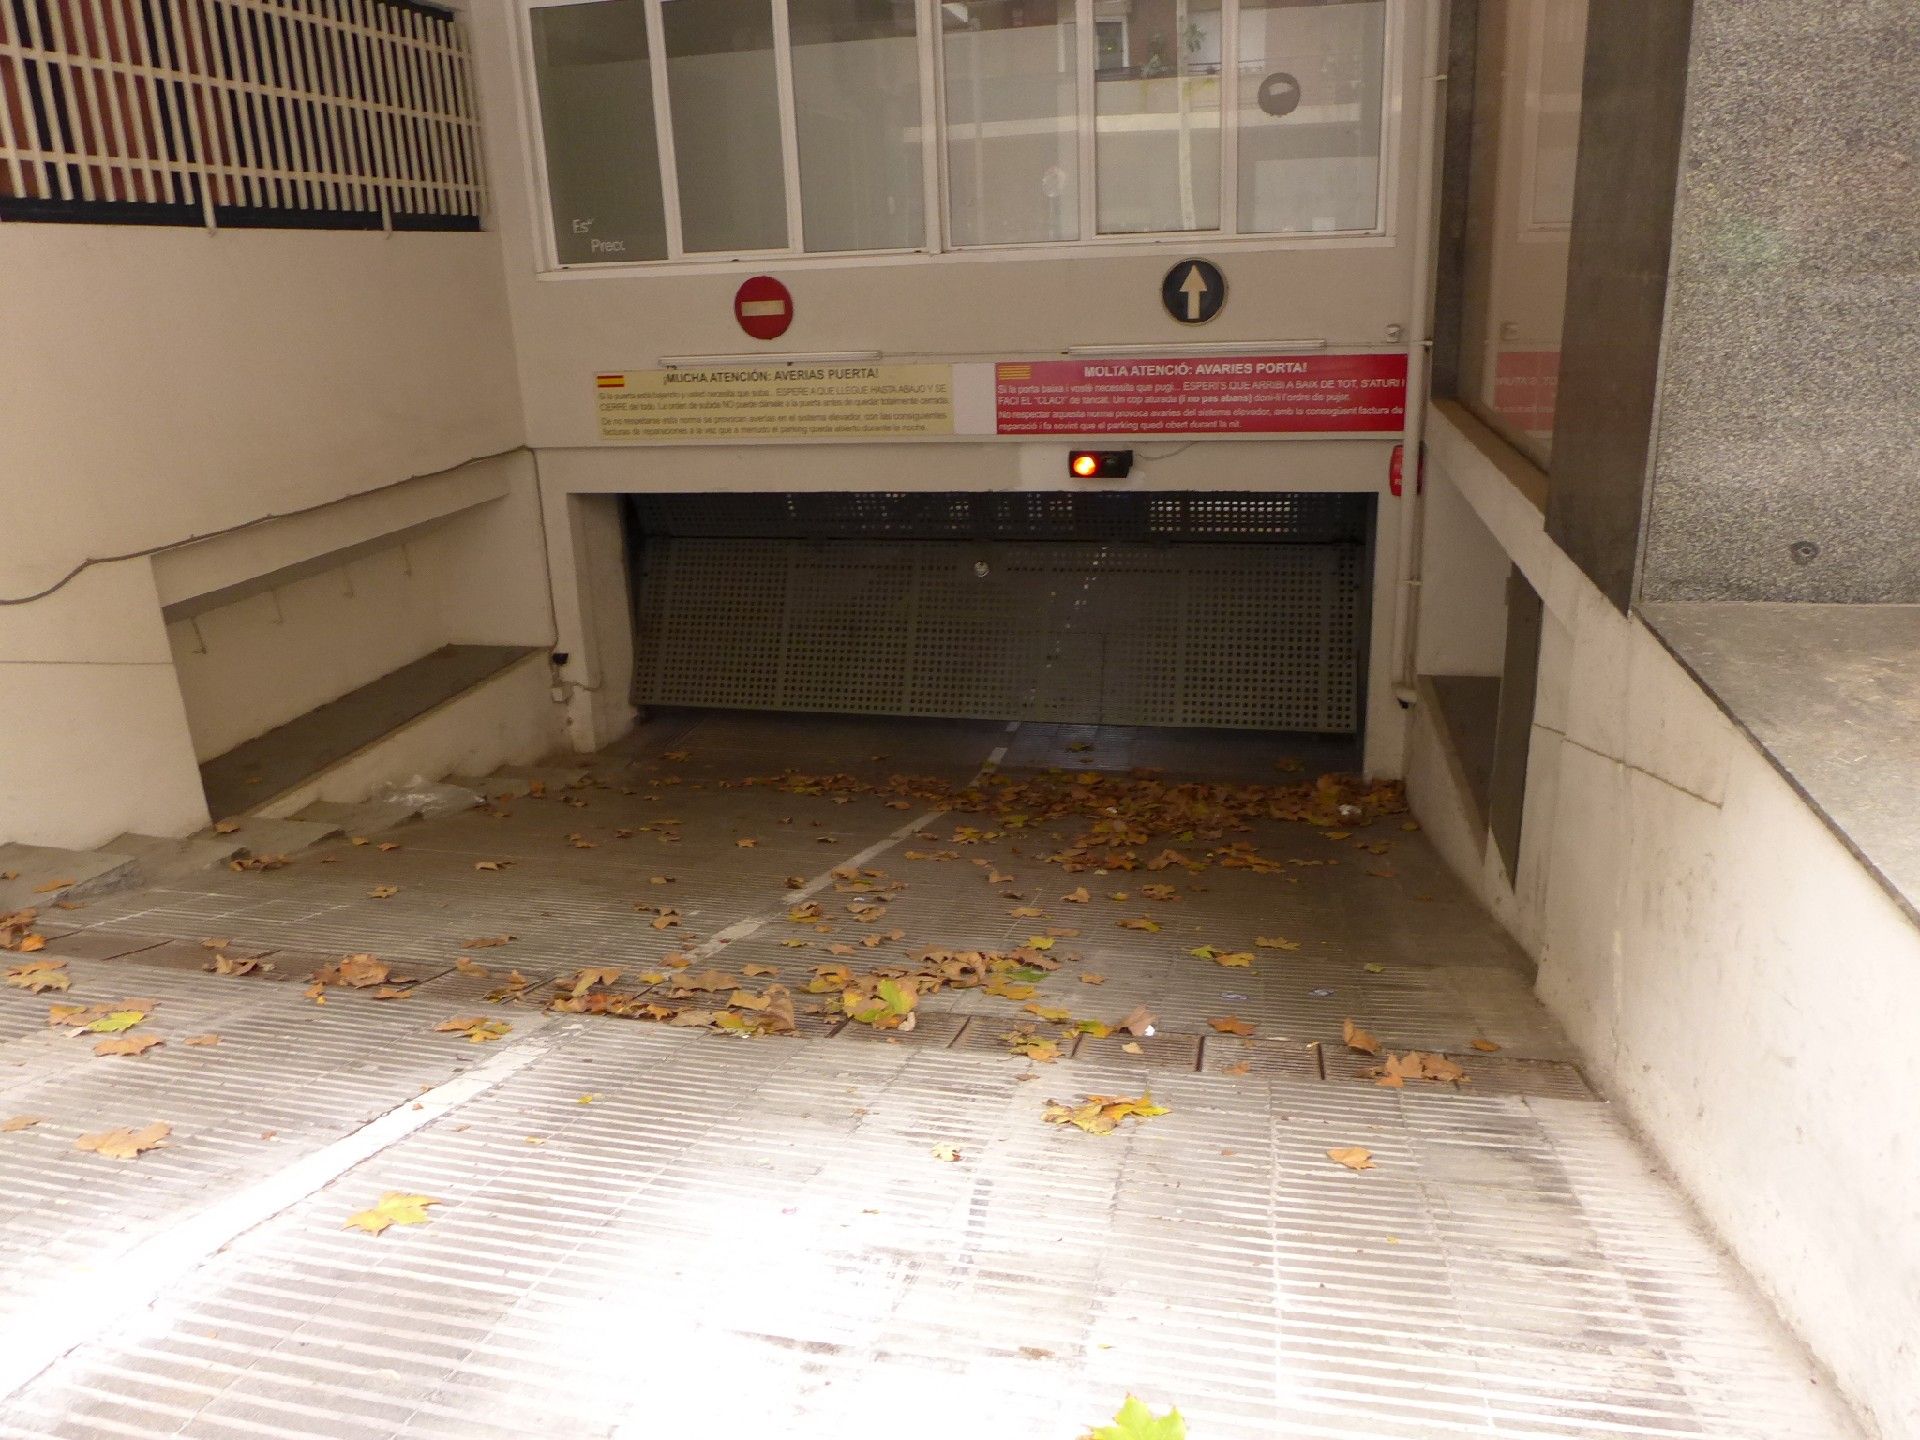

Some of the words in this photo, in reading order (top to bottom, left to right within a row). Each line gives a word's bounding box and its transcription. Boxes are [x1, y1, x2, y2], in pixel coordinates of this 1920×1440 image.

[1084, 366, 1129, 377] MOLTA
[1130, 362, 1193, 376] ATENCIÓ:
[1196, 363, 1253, 375] AVARIES
[1256, 362, 1308, 374] PORTA!
[776, 387, 808, 396] ESPERE
[817, 386, 834, 395] QUE
[898, 385, 924, 393] ABAJO
[935, 384, 947, 392] SE
[1229, 381, 1251, 390] QUE
[1296, 380, 1318, 389] BAIX
[1320, 380, 1335, 389] DE
[1021, 396, 1032, 404] EL
